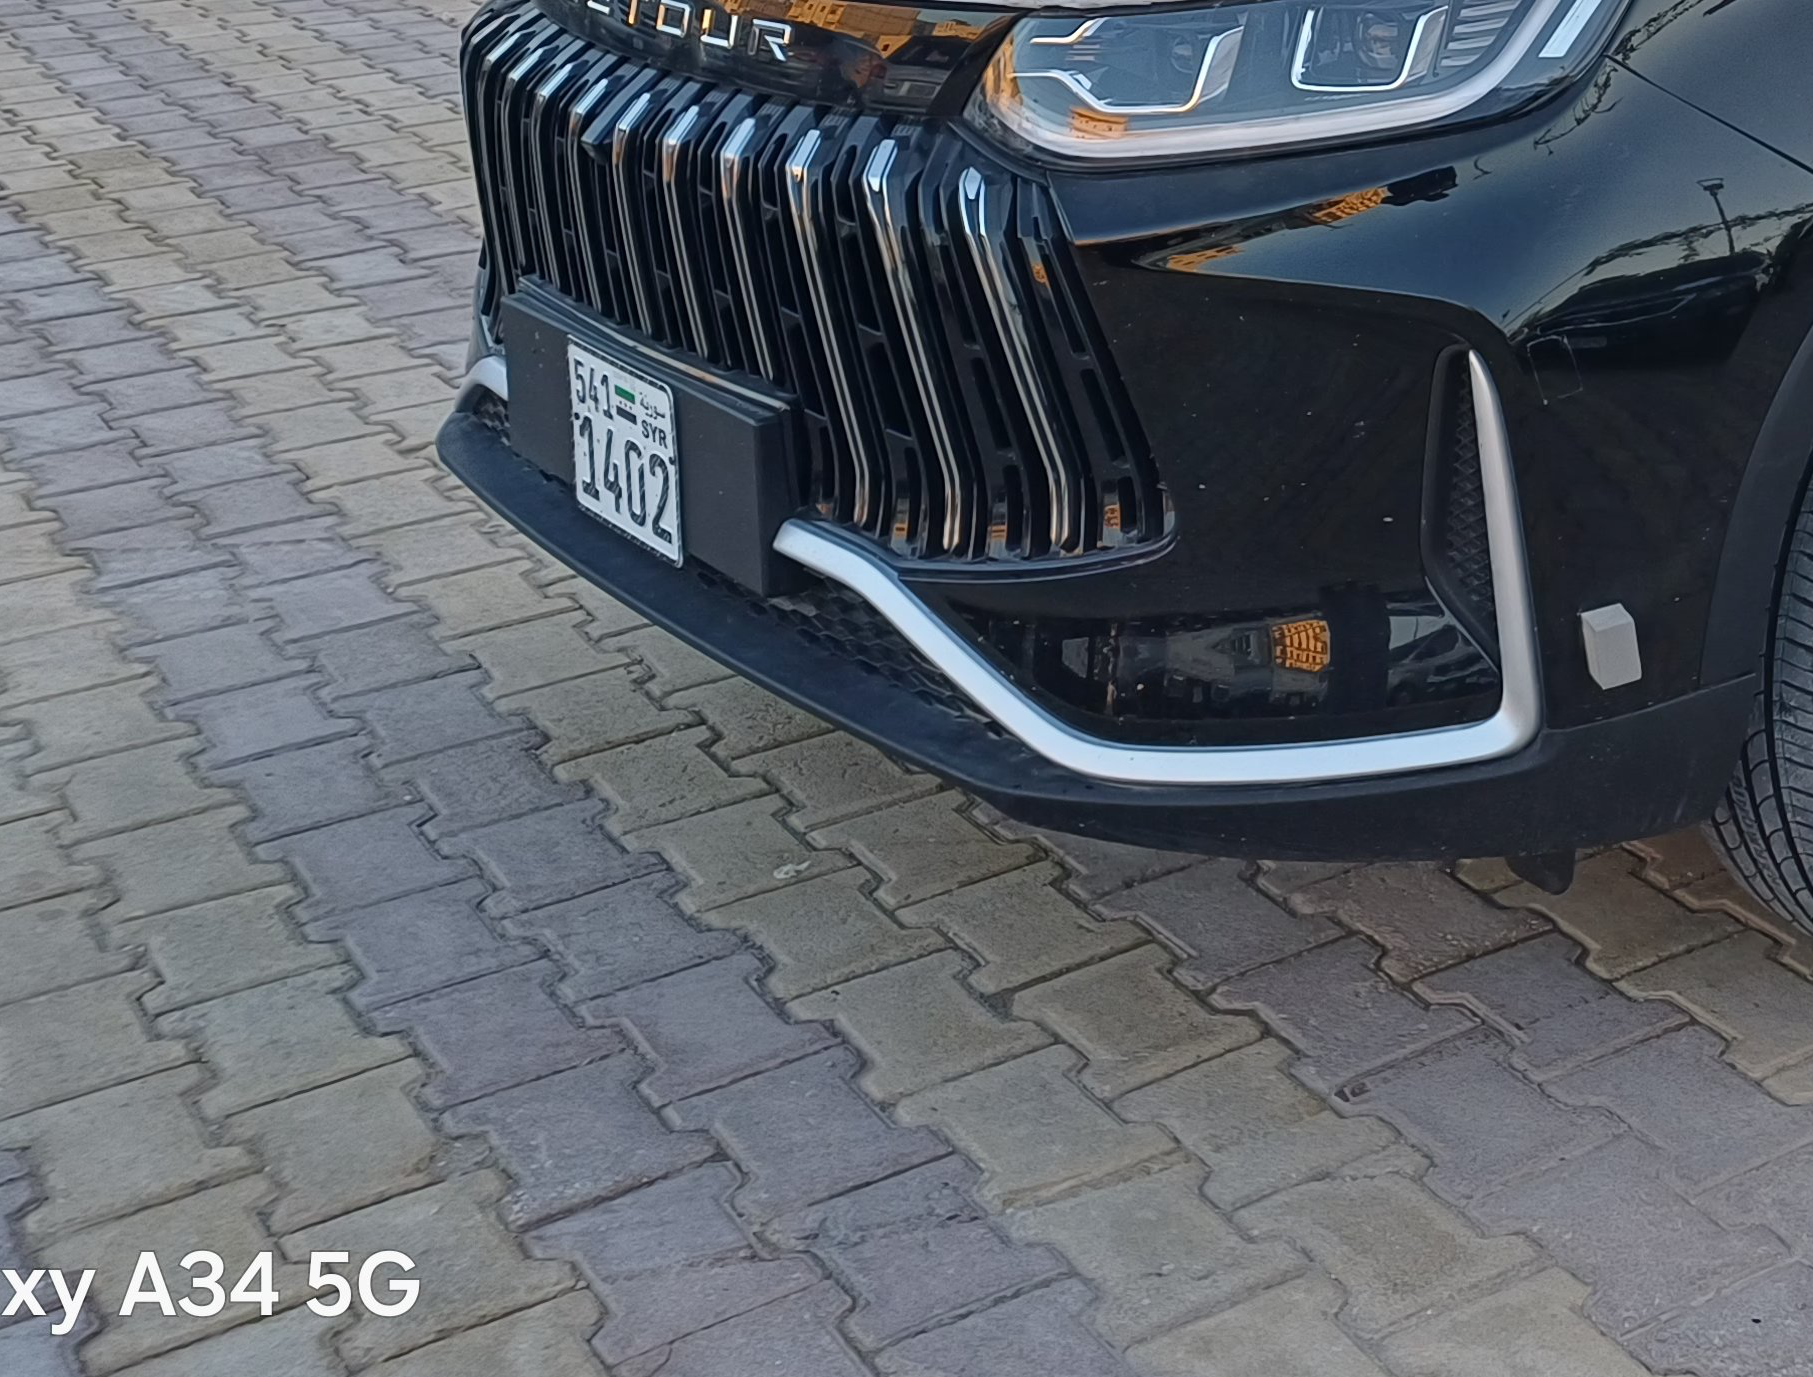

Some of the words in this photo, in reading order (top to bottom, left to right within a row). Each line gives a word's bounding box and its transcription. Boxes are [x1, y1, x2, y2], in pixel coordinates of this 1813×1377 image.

[573, 356, 614, 421] 541
[641, 419, 668, 449] SYR
[579, 415, 673, 545] 1402
